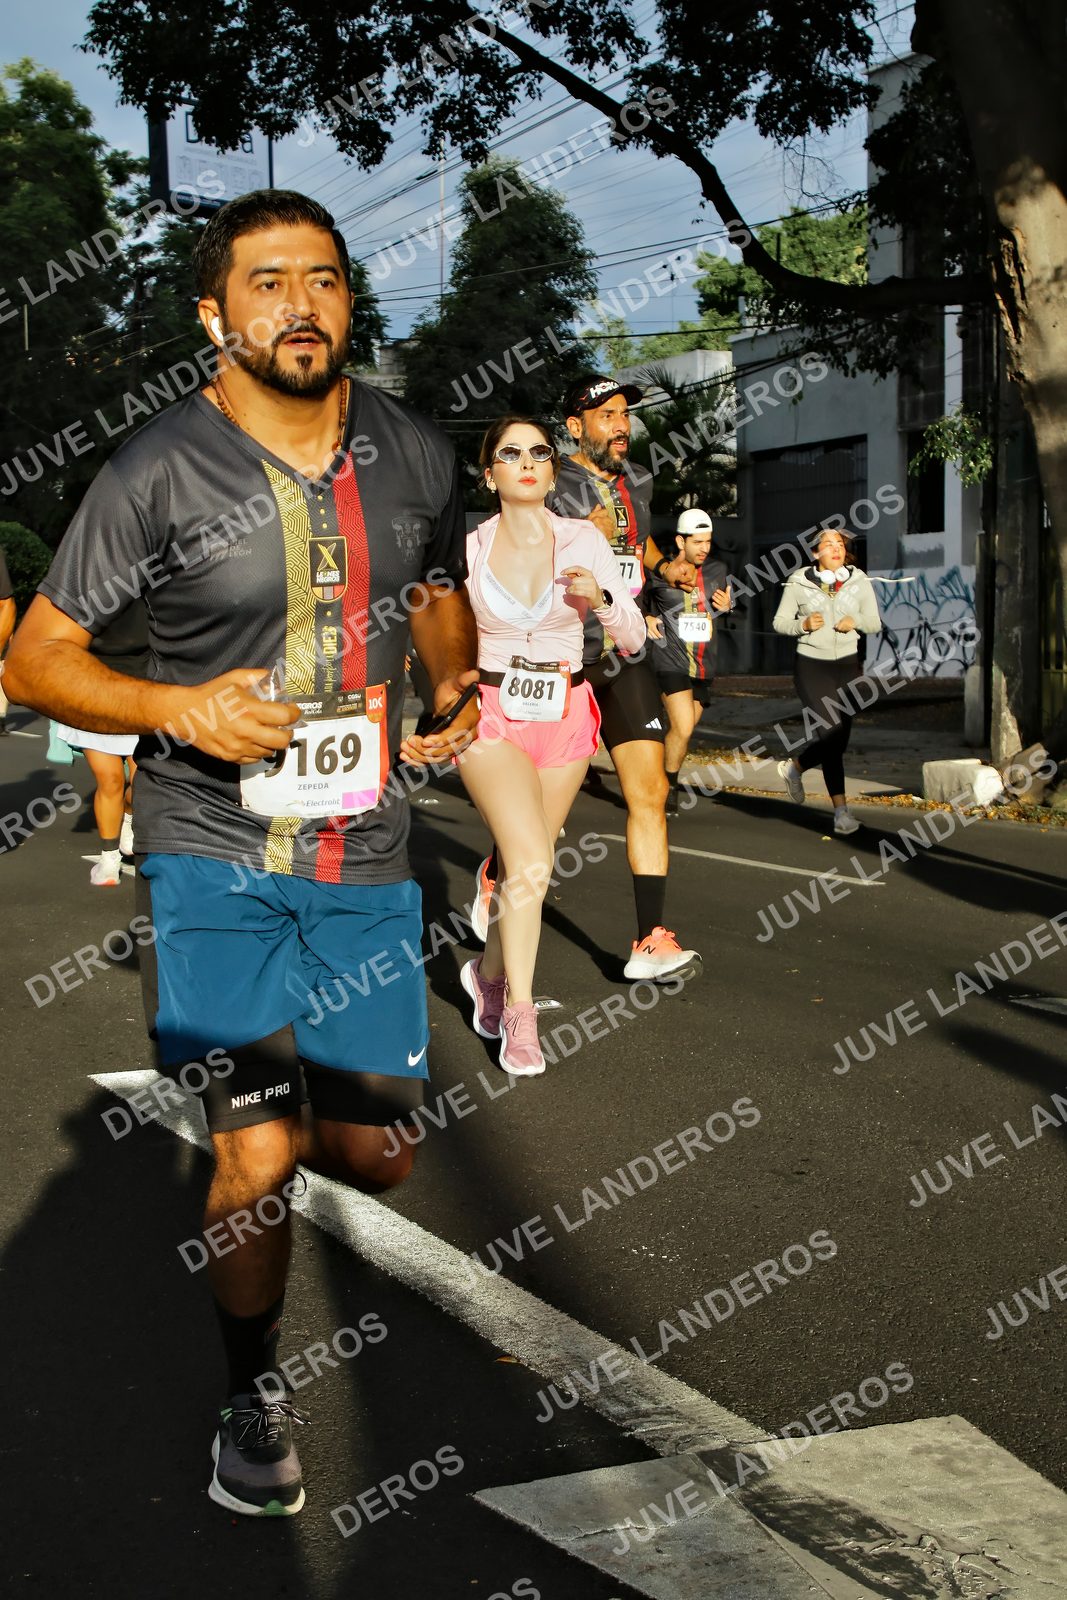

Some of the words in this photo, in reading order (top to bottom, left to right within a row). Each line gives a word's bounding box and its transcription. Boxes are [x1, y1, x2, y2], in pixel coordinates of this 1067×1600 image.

[684, 621, 706, 631] 7540
[508, 676, 555, 700] 8081
[297, 782, 330, 791] ZEPEDA
[231, 1091, 261, 1109] NIKE
[265, 1082, 290, 1100] PRO
